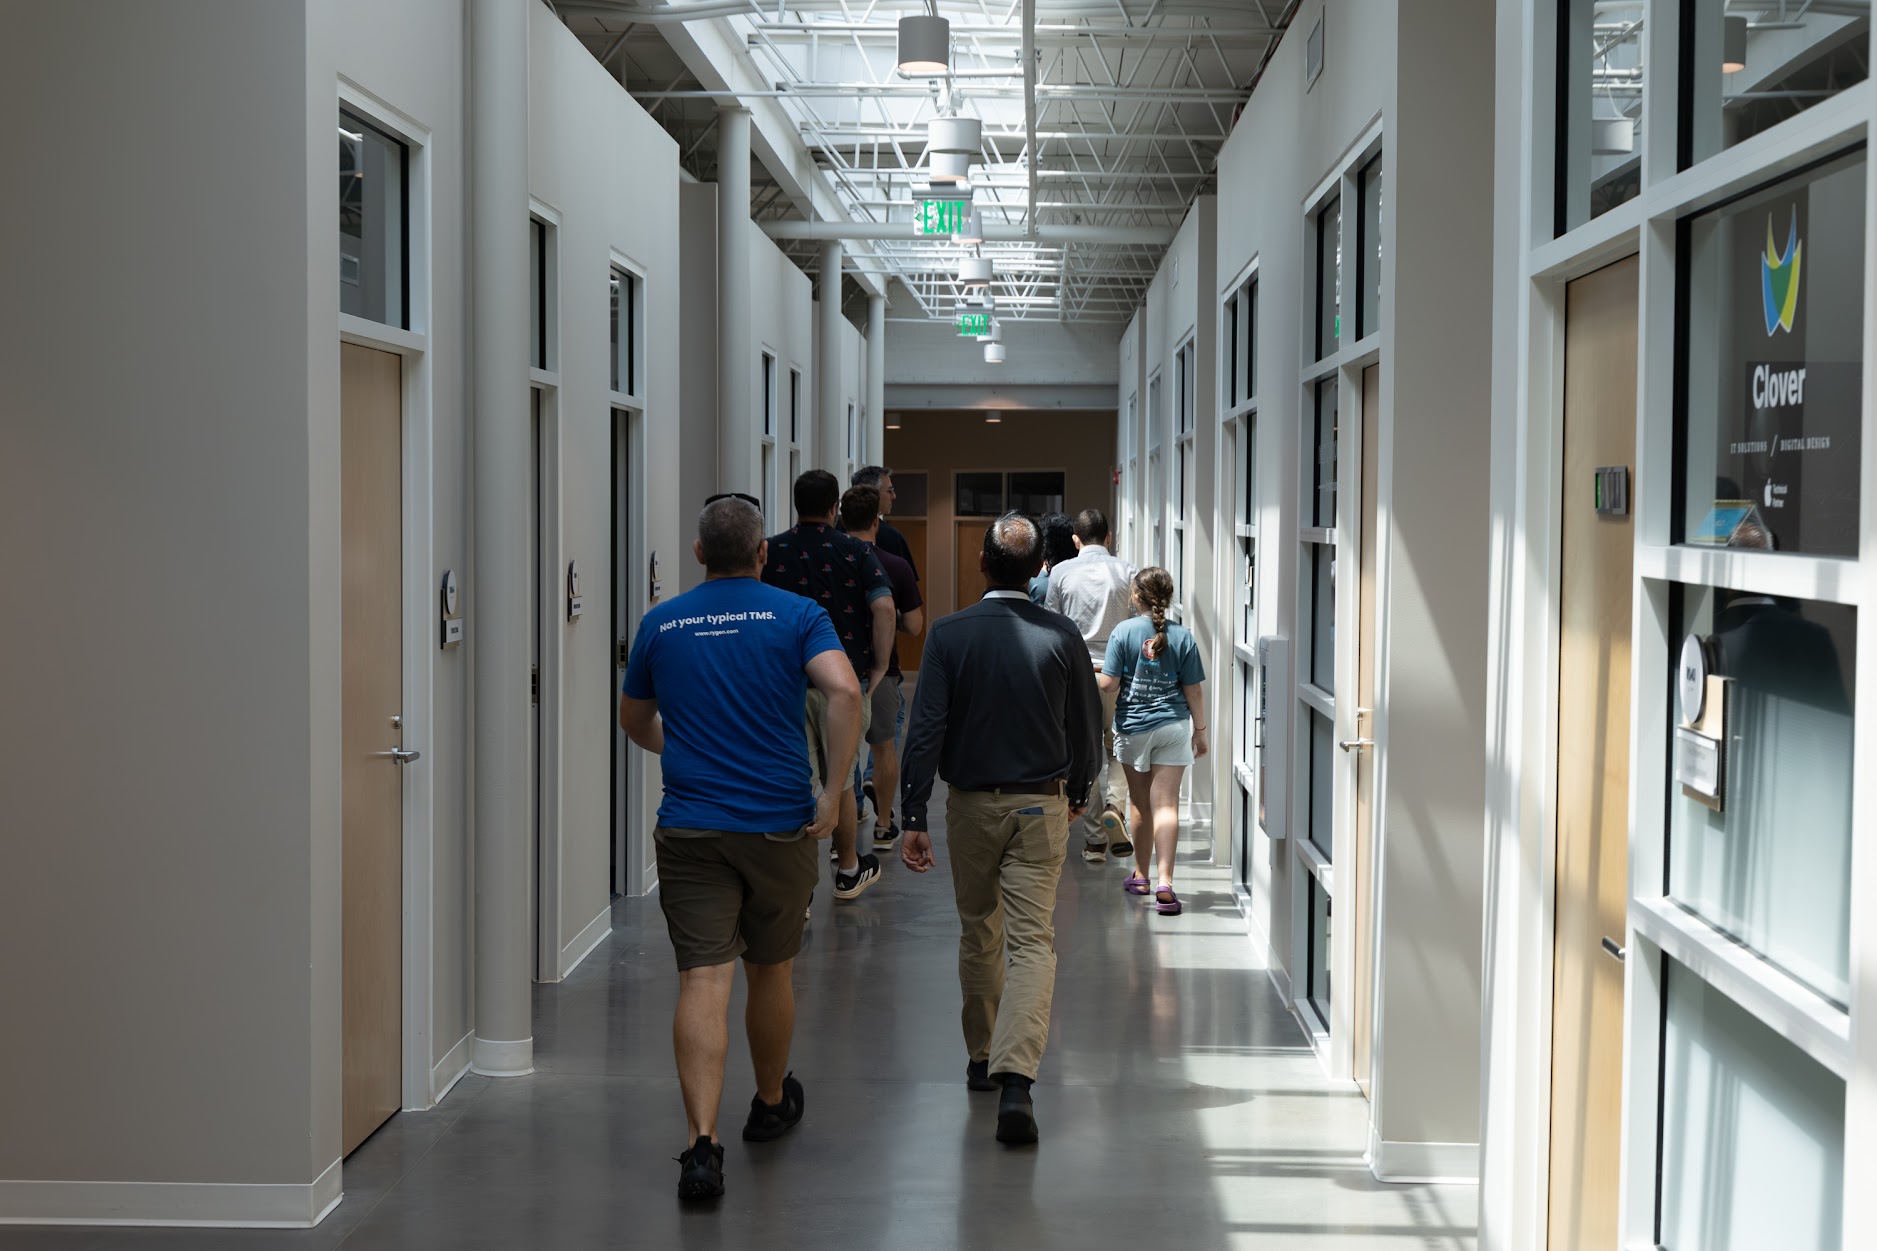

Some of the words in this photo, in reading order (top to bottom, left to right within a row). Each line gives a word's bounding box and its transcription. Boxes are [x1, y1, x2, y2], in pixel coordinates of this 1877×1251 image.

[923, 201, 965, 234] EXIT
[961, 314, 989, 336] EXIT
[1753, 364, 1806, 409] Clover
[1737, 441, 1768, 454] SOLUTIONS
[1780, 438, 1805, 452] DIGITAL
[1806, 436, 1831, 450] DESIGN
[660, 620, 677, 633] Not
[678, 616, 705, 629] your
[707, 612, 747, 625] typical
[749, 611, 777, 620] TMS.
[694, 628, 739, 637] www.rygen.com
